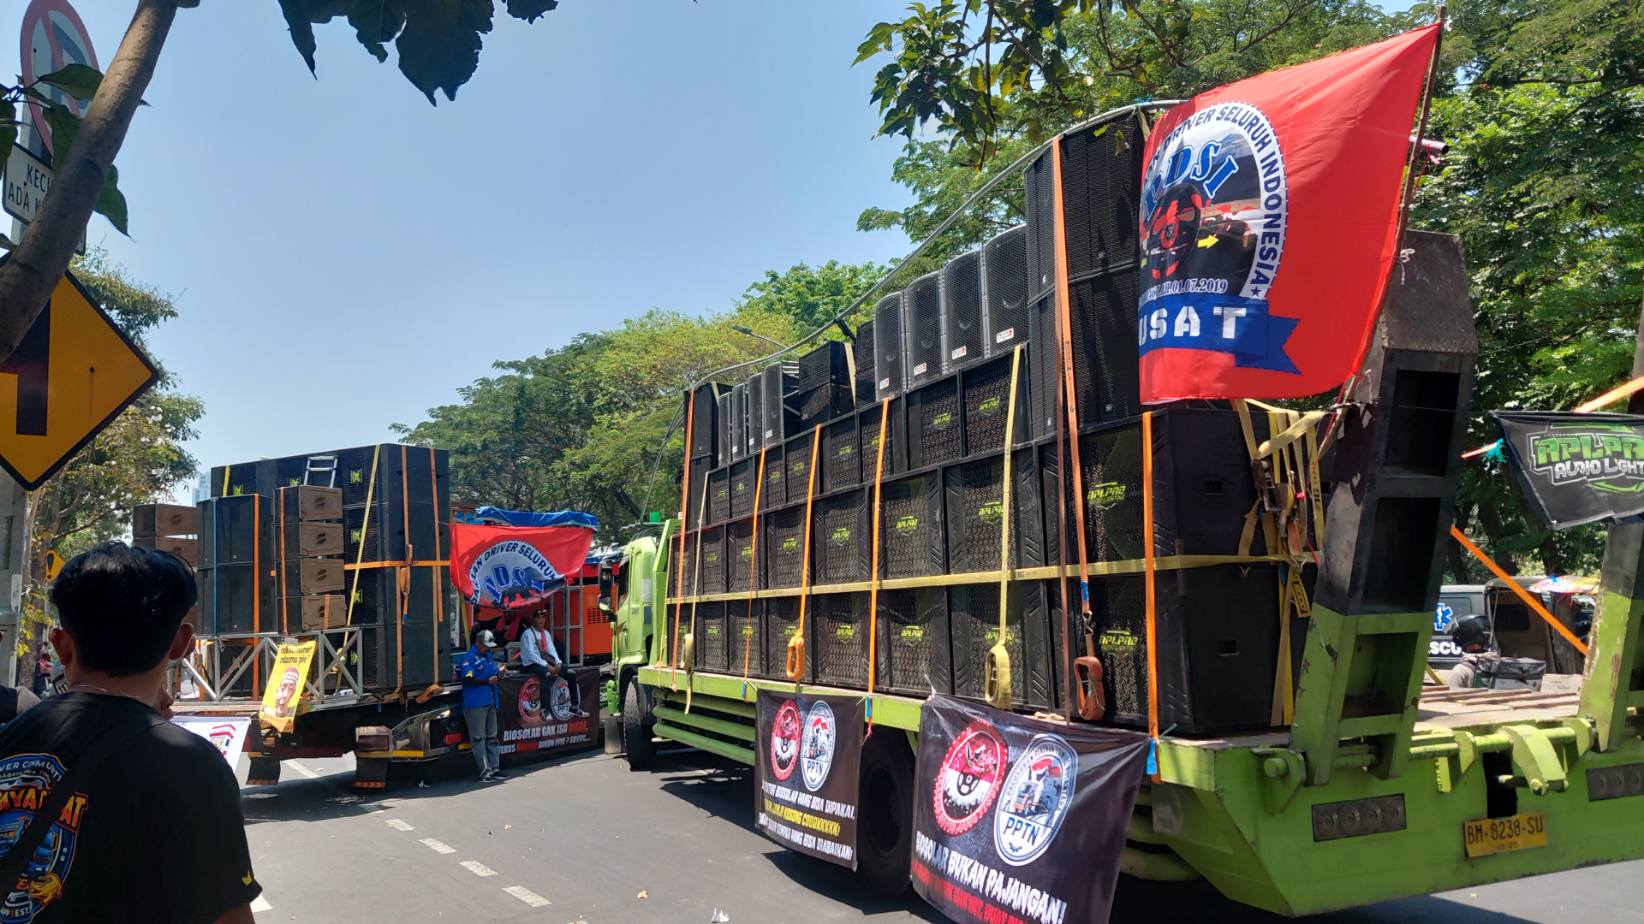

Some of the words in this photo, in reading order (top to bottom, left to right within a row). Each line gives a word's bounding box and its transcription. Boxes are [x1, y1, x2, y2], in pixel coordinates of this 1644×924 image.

[7, 181, 30, 213] ADA
[1215, 105, 1273, 154] SELURUH
[1250, 151, 1283, 287] INDONESIA
[484, 542, 519, 561] DRIVER
[503, 727, 540, 742] BIOSOLAR
[541, 724, 556, 738] GAK
[1003, 815, 1041, 847] PPTN
[947, 850, 989, 893] BUKAN
[987, 869, 1068, 924] PAJANGAN!
